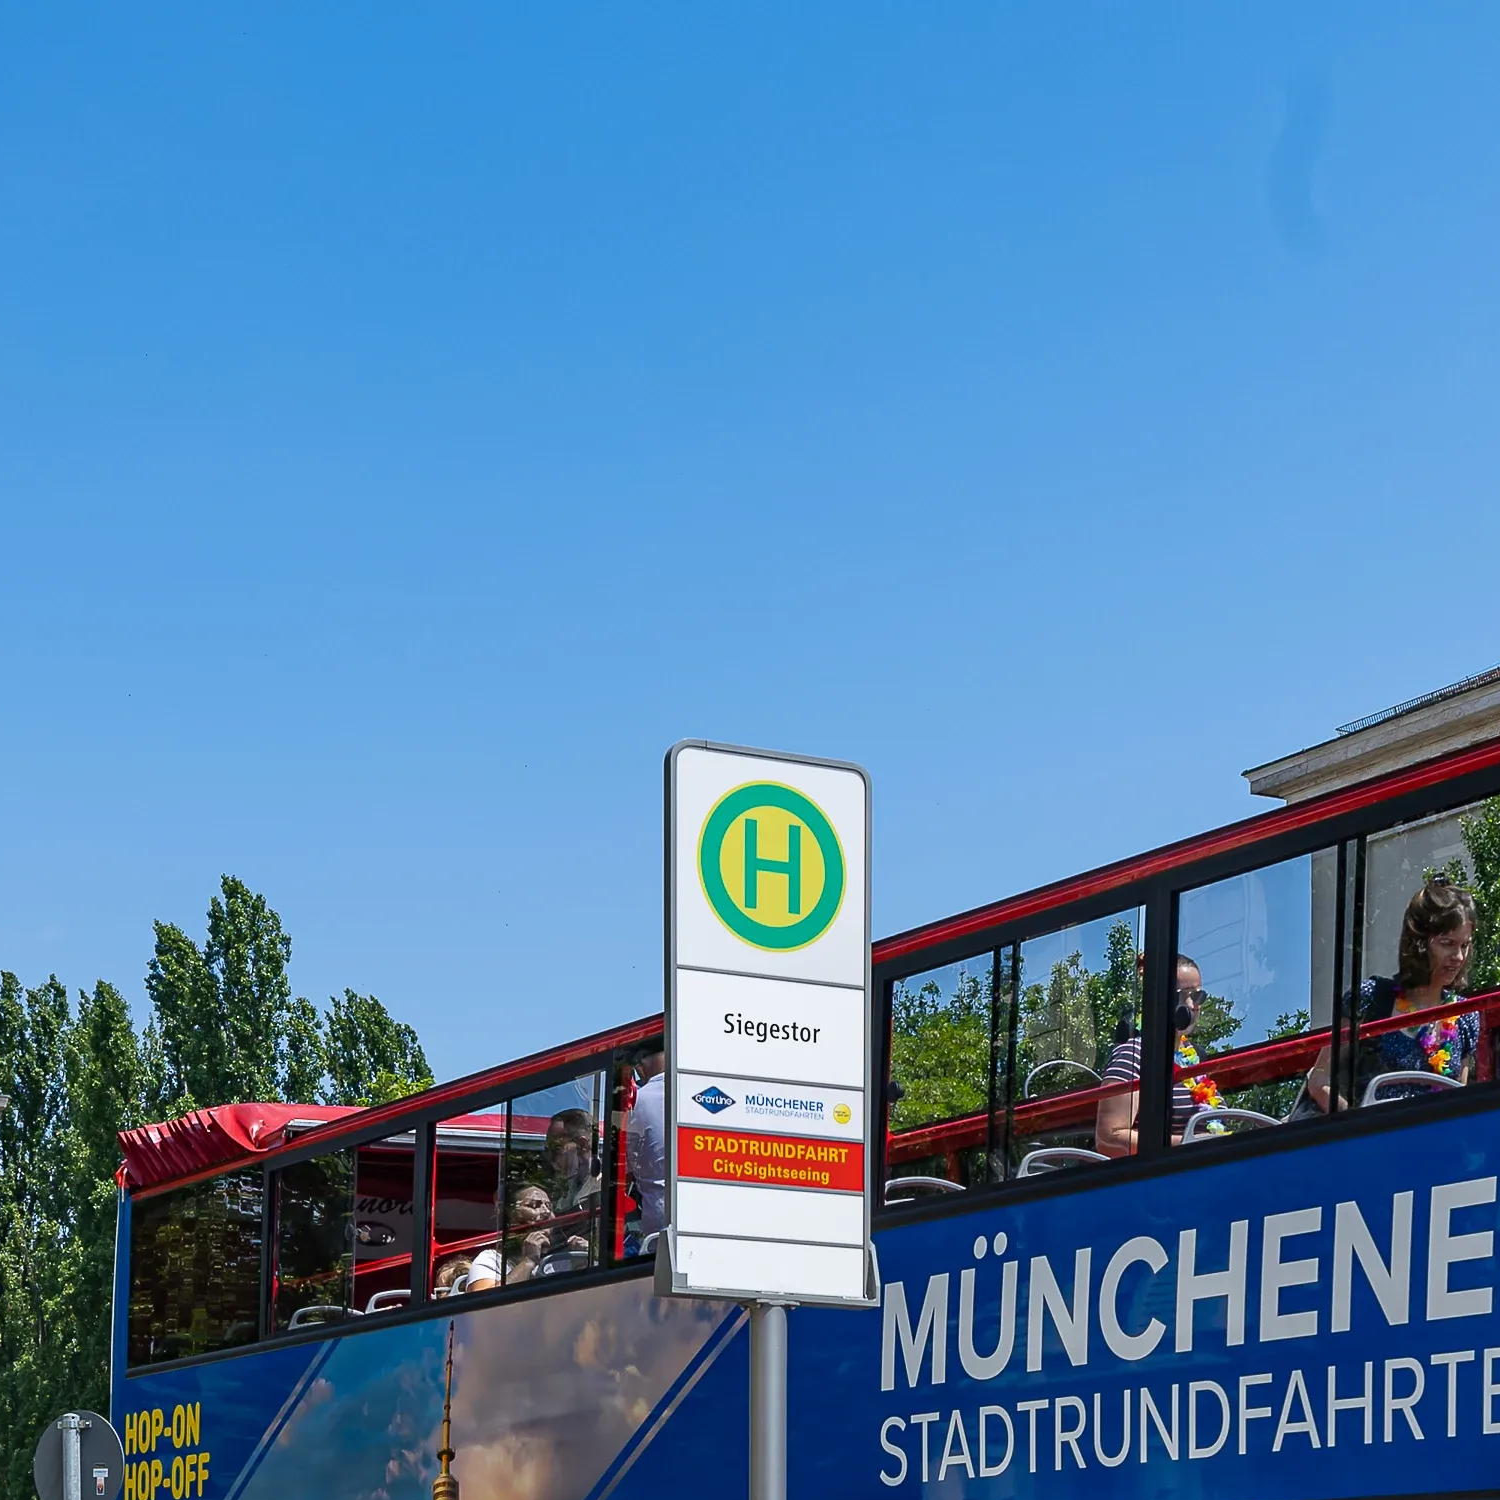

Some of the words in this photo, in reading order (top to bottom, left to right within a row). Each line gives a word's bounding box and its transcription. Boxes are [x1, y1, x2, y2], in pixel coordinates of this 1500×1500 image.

[744, 818, 801, 915] H
[724, 1013, 820, 1044] Siegestor
[745, 1093, 824, 1112] MÜNCHENER
[745, 1106, 824, 1121] STADTRUNDFAHRTEN
[694, 1135, 849, 1164] STADTRUNDFAHRT
[713, 1158, 830, 1185] CitySightseeing
[124, 1401, 201, 1456] HOP-ON
